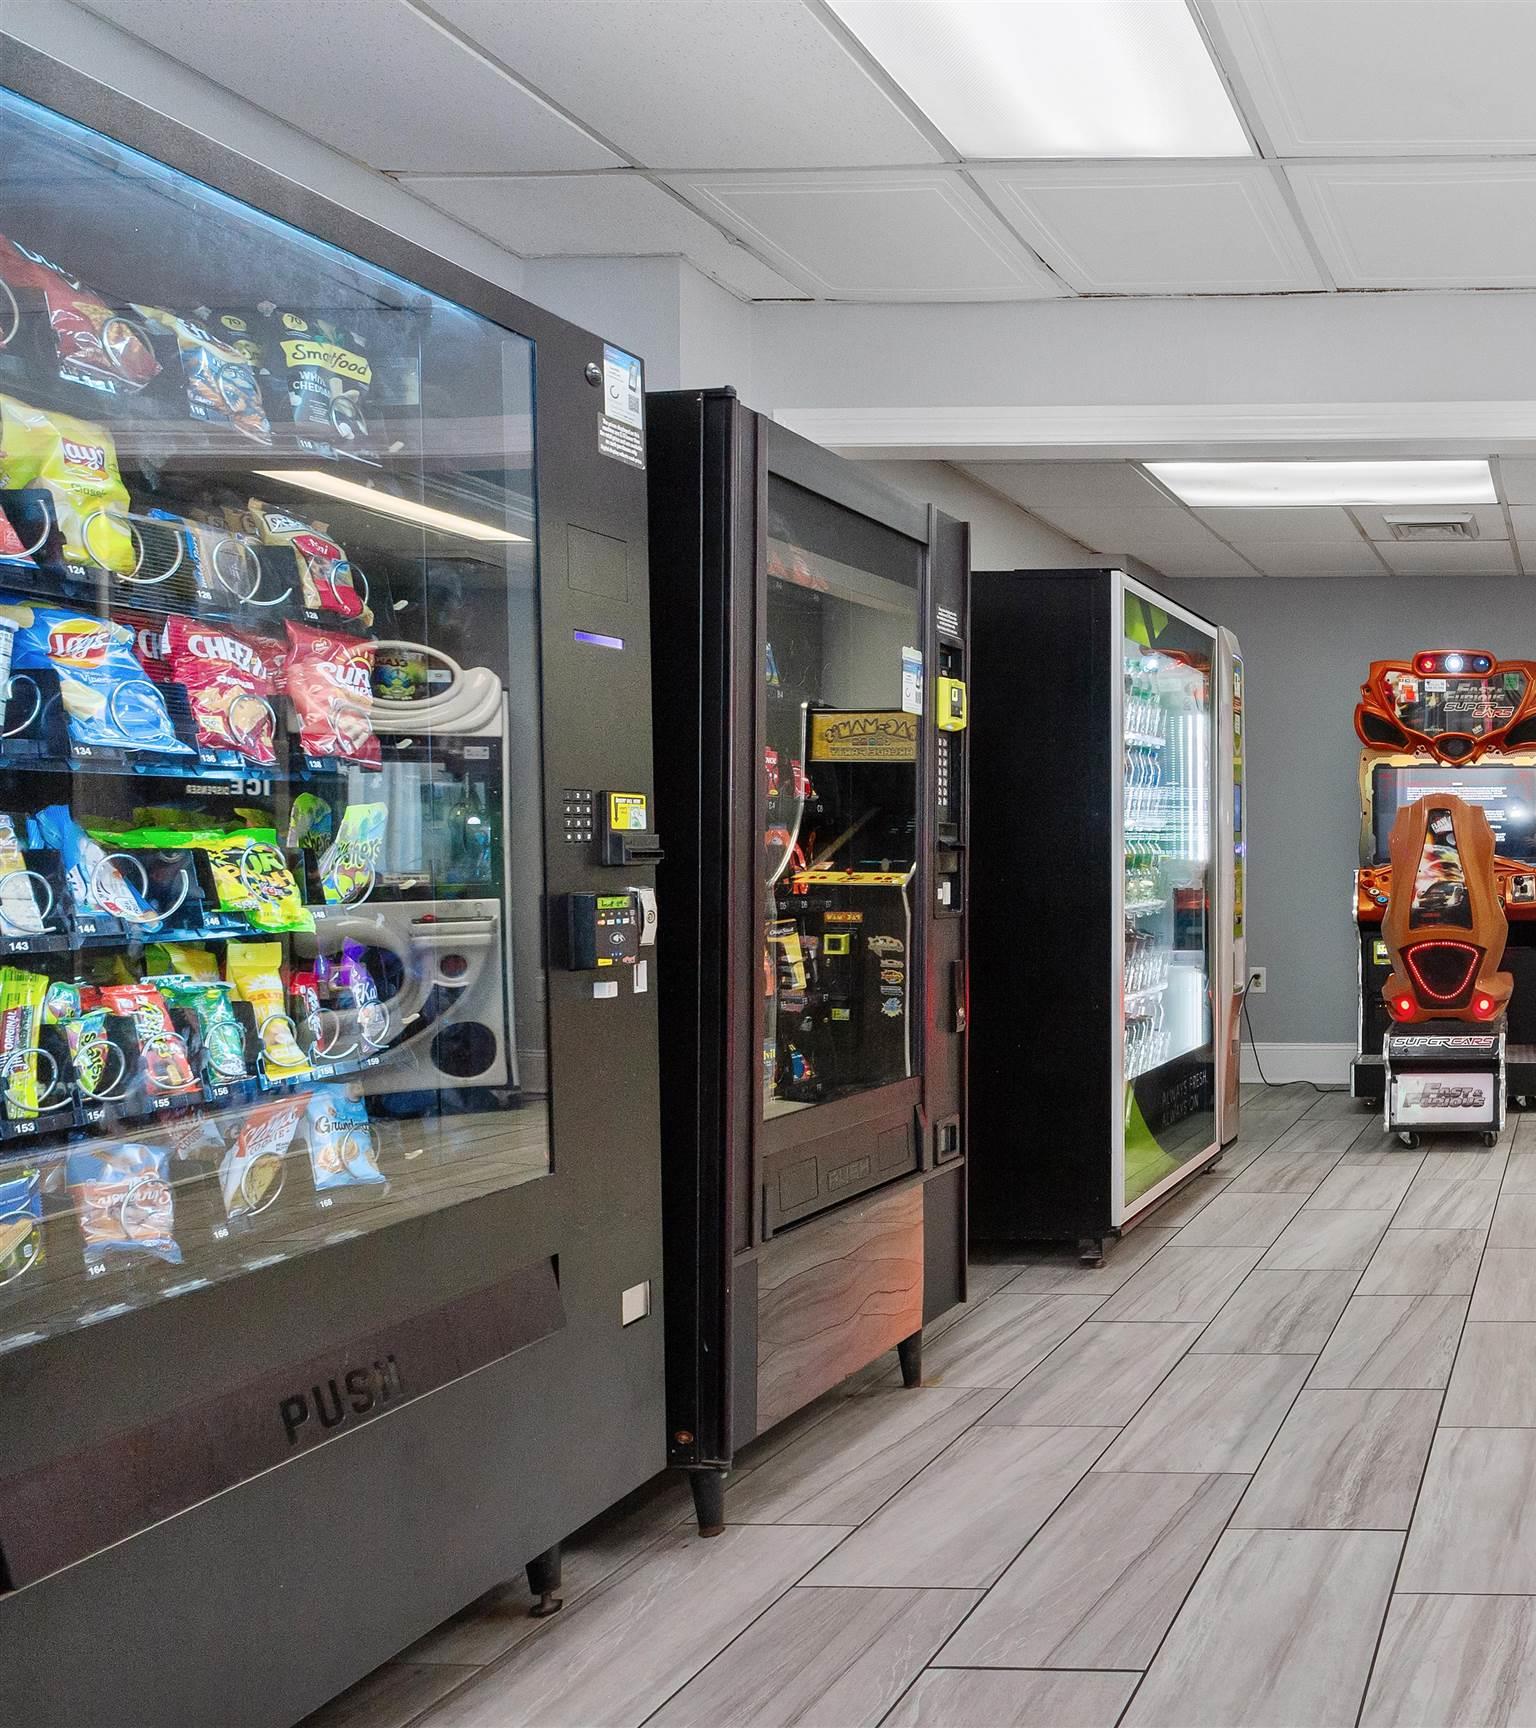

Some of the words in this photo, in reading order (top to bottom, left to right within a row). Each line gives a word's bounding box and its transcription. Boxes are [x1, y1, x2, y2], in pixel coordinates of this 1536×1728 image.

[62, 440, 104, 471] ay's
[67, 565, 86, 576] 124
[1443, 702, 1498, 712] SUPER
[1472, 707, 1514, 718] CARS
[74, 747, 92, 756] 134
[78, 924, 96, 934] 144
[8, 942, 29, 951] 143
[4, 1010, 17, 1050] ORIGINAL
[1393, 1036, 1495, 1048] SUPERCARS
[213, 1087, 229, 1096] 156
[1421, 1082, 1473, 1102] FAST
[153, 1098, 170, 1108] 155
[1403, 1092, 1486, 1108] FURIOUS
[87, 1111, 105, 1121] 154
[14, 1122, 35, 1133] 153
[88, 1263, 106, 1275] 164
[278, 1354, 402, 1446] PUSH
